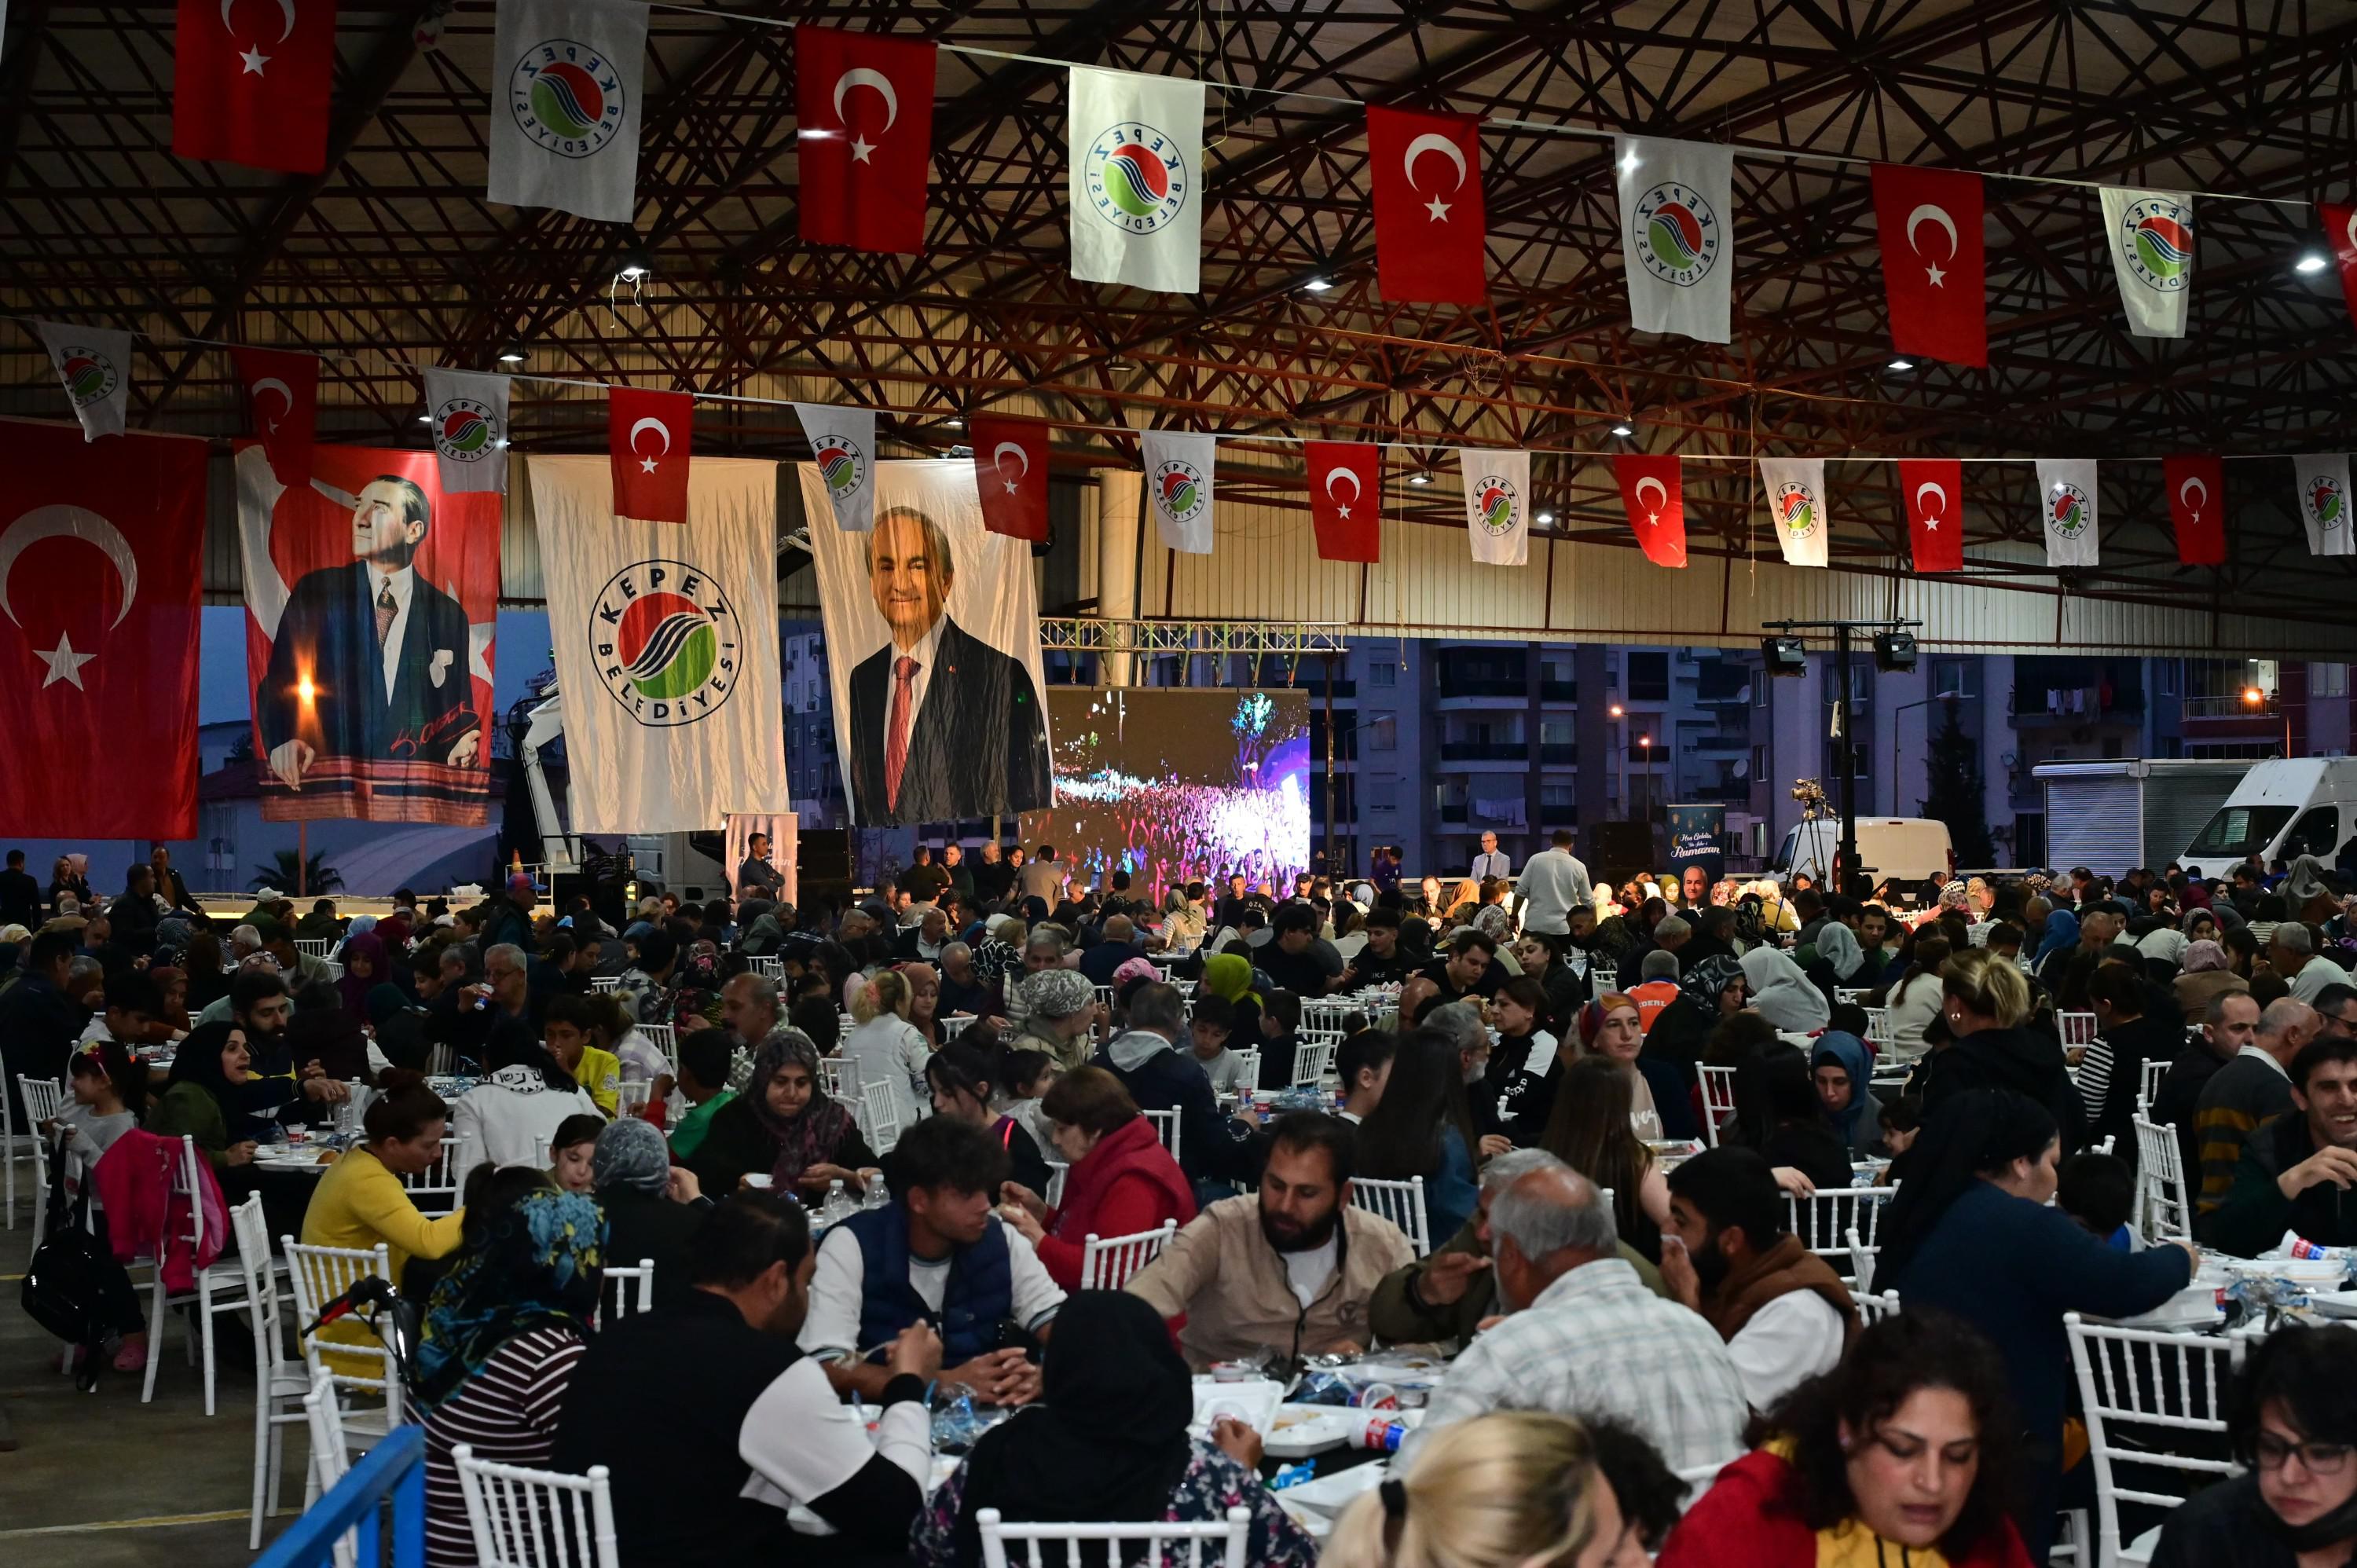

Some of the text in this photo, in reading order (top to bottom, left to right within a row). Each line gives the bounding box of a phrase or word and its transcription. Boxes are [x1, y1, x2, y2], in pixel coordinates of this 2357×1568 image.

[438, 401, 493, 423] KEPEZ
[816, 438, 860, 461] EPEZ
[1157, 463, 1201, 485] KEPEZ
[1475, 478, 1516, 500] KEPEZ
[599, 568, 728, 625] KEPEZ
[1670, 845, 1721, 859] Ramazan
